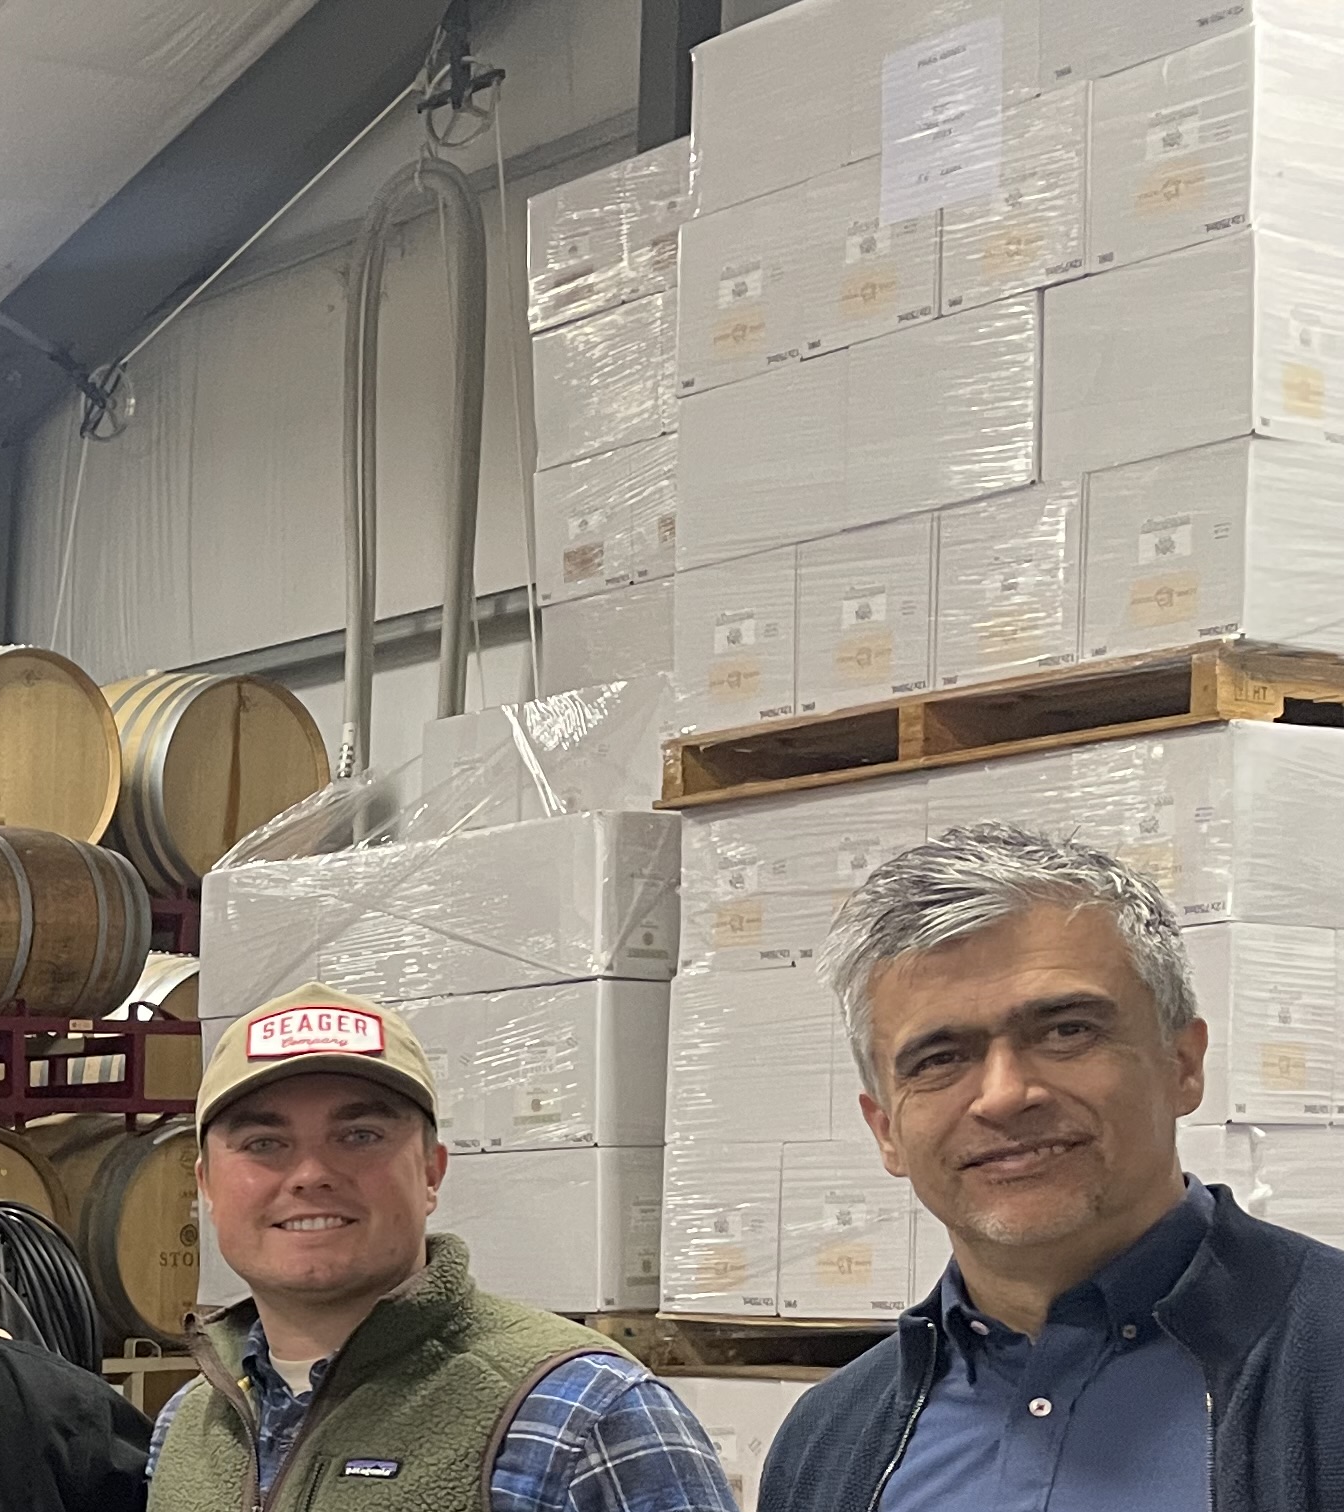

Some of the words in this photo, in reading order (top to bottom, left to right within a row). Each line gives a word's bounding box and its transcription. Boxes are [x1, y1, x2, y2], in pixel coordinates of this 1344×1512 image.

[263, 1014, 367, 1039] SEAGER
[281, 1037, 349, 1048] Company
[159, 1252, 200, 1267] STO
